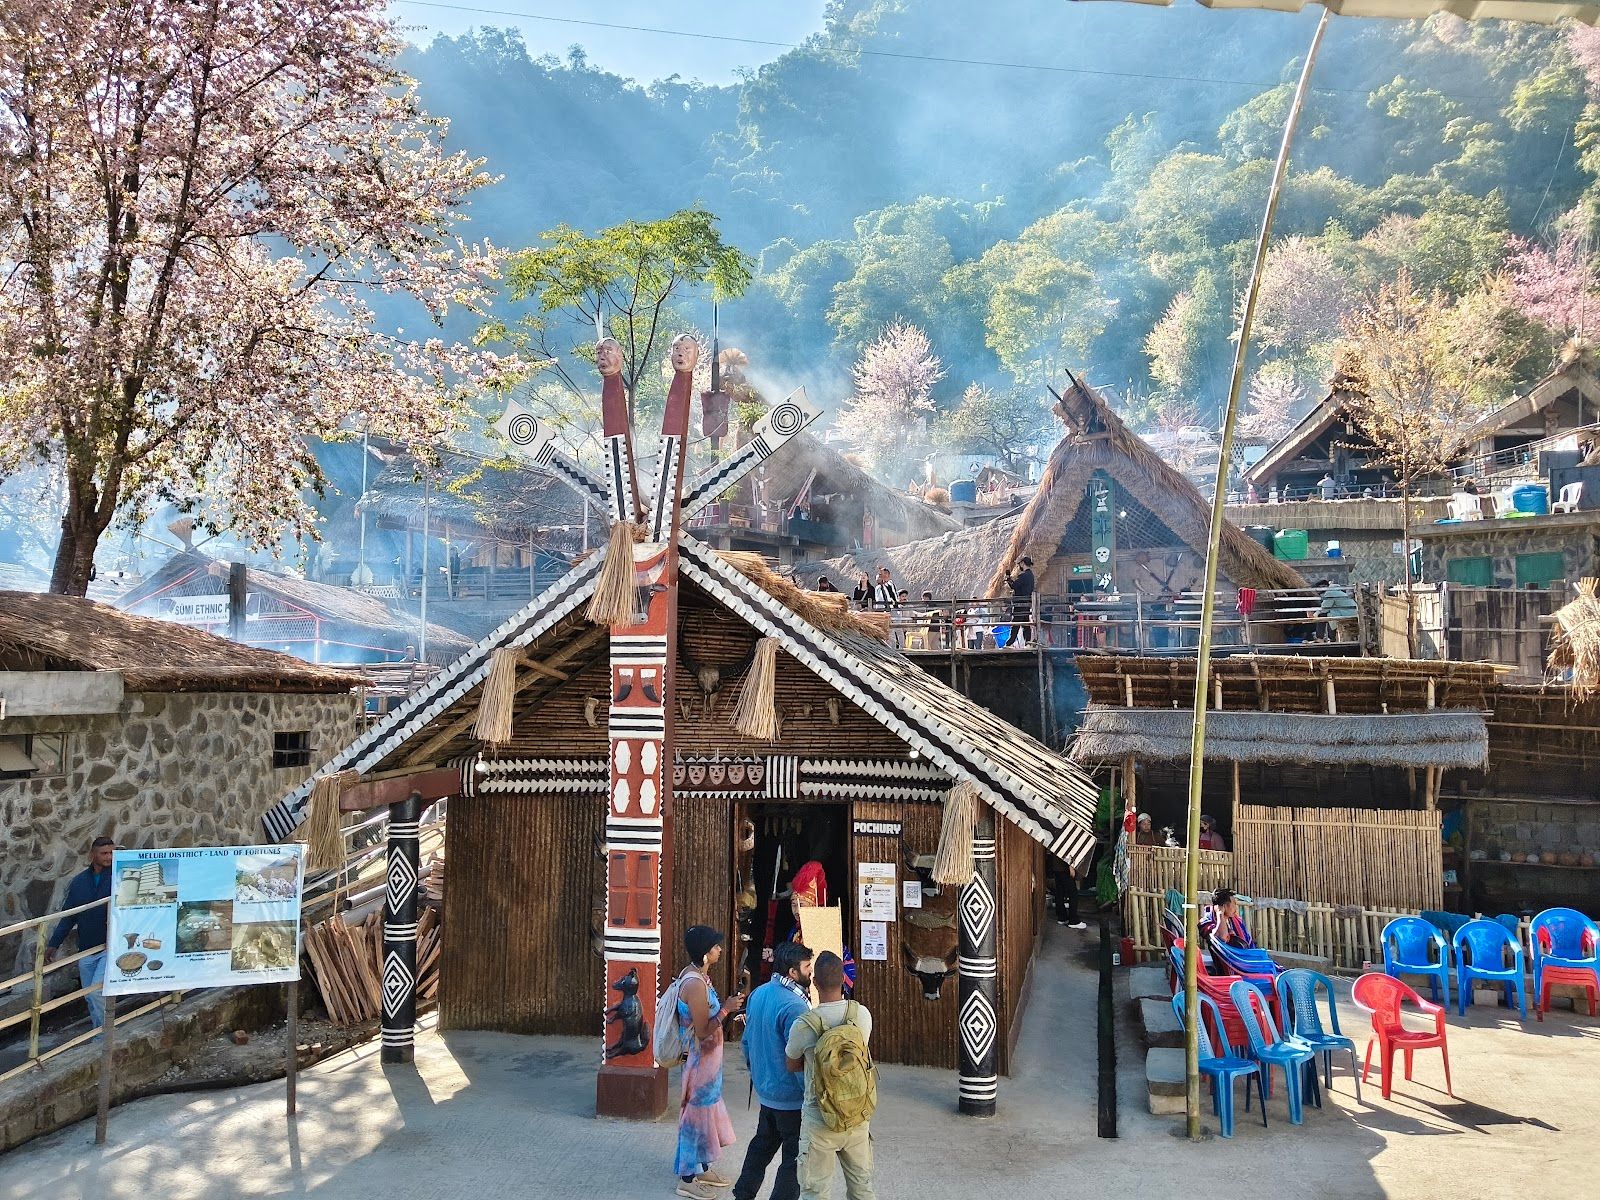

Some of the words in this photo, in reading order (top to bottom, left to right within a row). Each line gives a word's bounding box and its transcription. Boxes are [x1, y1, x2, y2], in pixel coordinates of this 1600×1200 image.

[195, 603, 223, 614] ETHNIC
[853, 822, 901, 834] POCHURY
[169, 850, 204, 859] DISTRICT
[209, 849, 229, 857] LAND
[245, 847, 281, 856] FORTUNES
